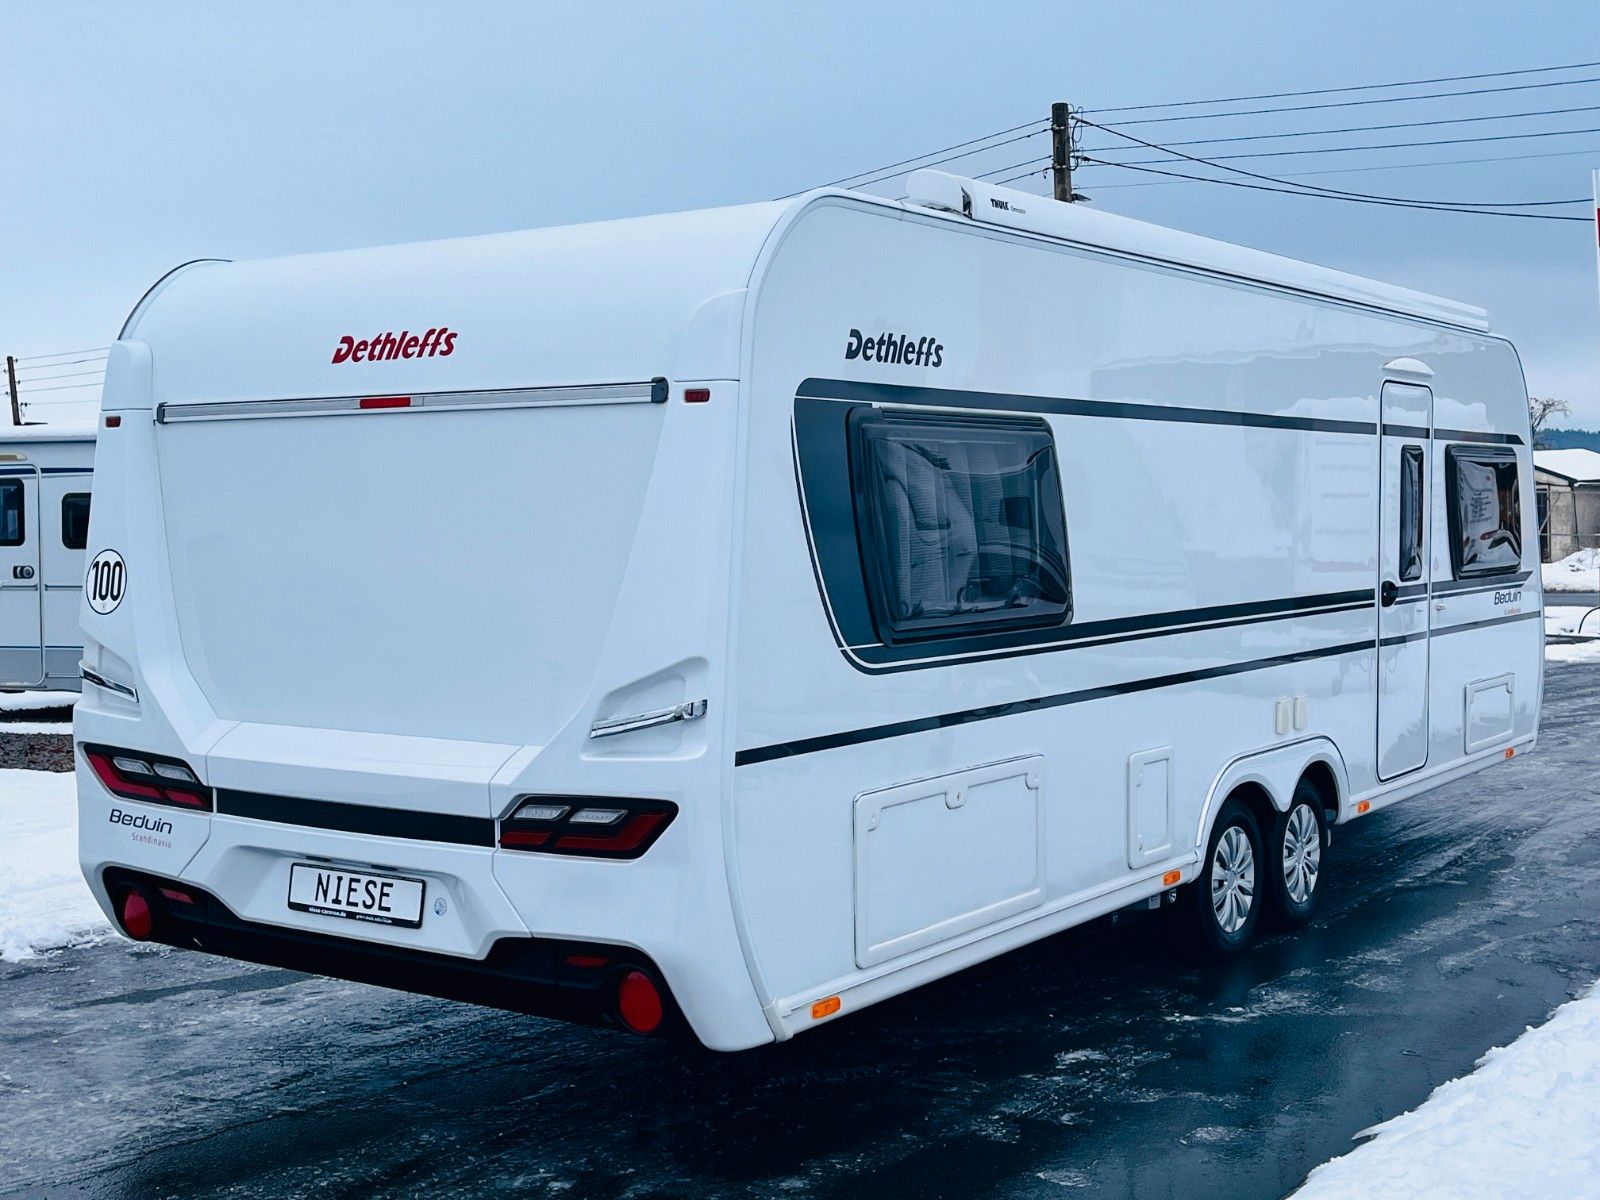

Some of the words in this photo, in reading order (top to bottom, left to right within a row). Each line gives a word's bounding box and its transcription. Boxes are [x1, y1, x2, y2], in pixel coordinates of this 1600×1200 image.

[990, 198, 1009, 210] THULE
[331, 327, 458, 364] Dethleffs
[845, 328, 944, 368] Dethleffs
[92, 560, 123, 601] 100
[1494, 590, 1522, 605] Beduin
[109, 808, 173, 835] Beduin
[131, 831, 172, 849] Scandinavia
[314, 872, 394, 913] NIESE
